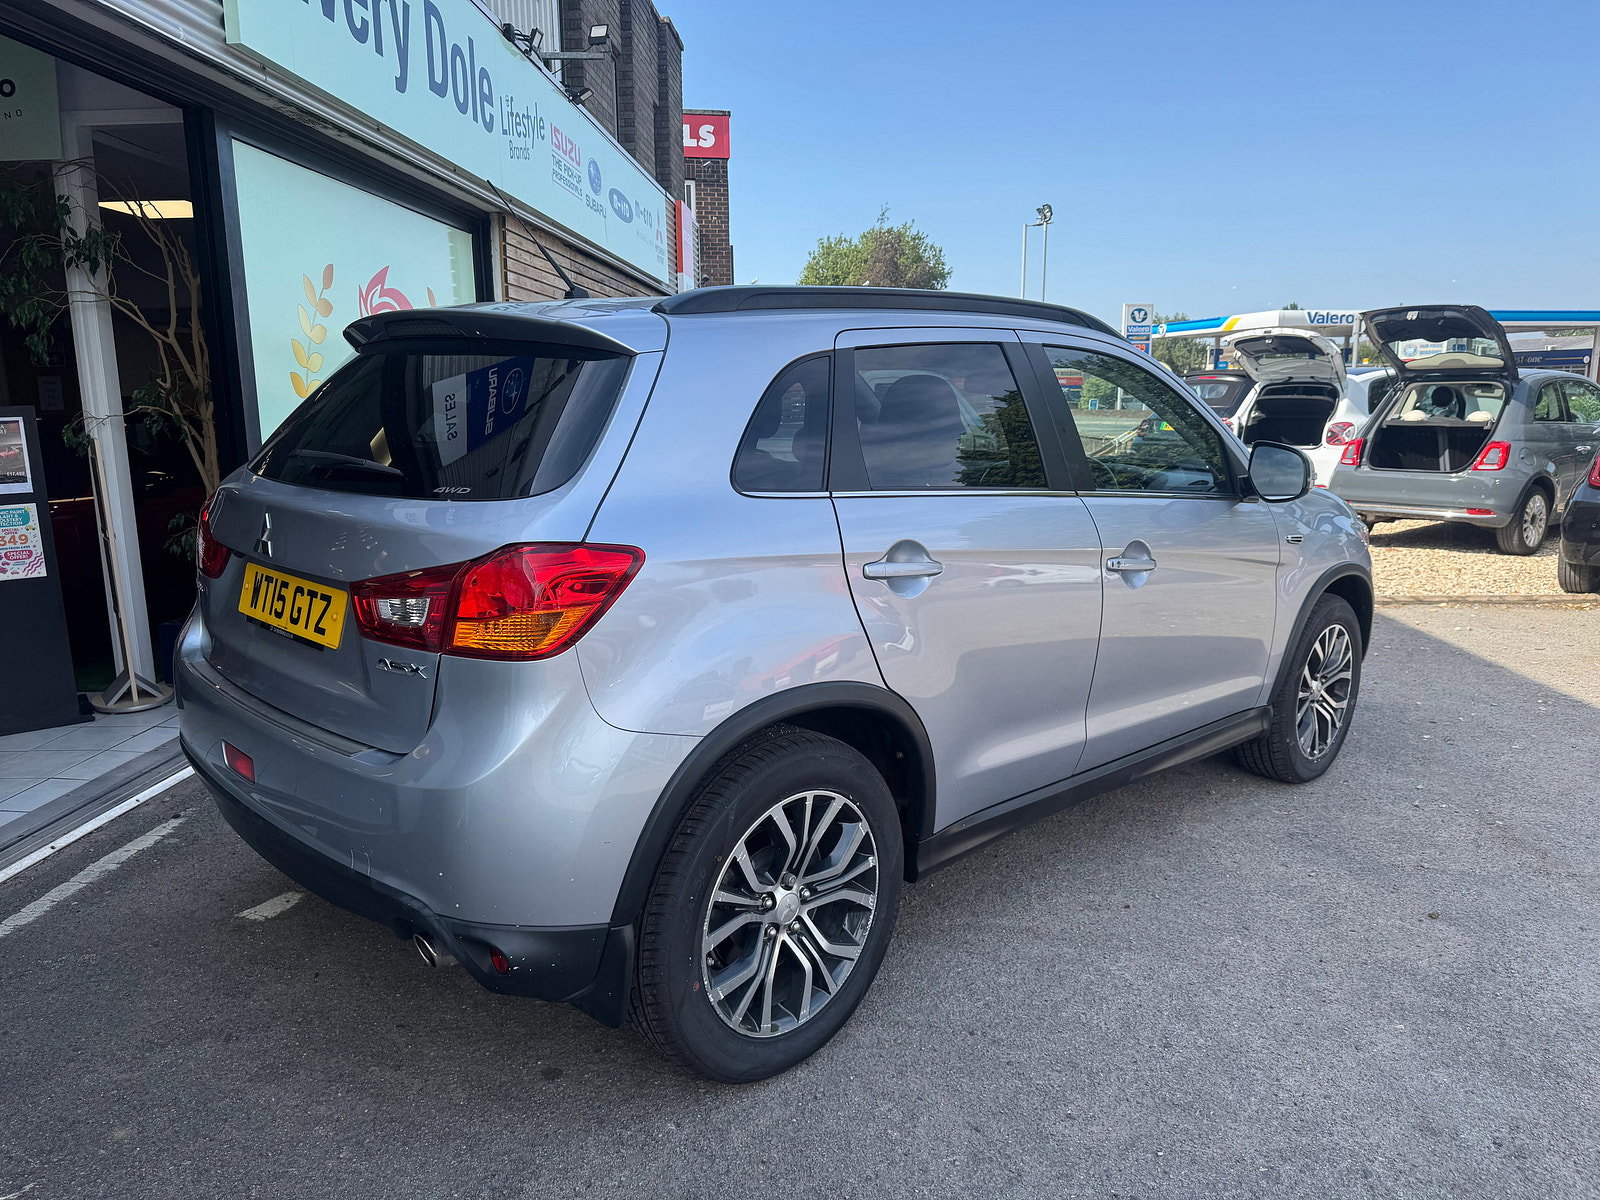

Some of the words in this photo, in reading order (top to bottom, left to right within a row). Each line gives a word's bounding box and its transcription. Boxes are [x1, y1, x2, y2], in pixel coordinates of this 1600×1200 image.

[301, 0, 410, 93] ery
[424, 0, 494, 133] Dole
[500, 95, 545, 149] Lifestyle
[550, 123, 580, 167] ISUZU
[683, 124, 715, 147] LS
[509, 140, 530, 160] Brands
[552, 154, 562, 171] THE
[585, 193, 607, 219] SUBARU
[1307, 311, 1355, 324] Valero
[433, 486, 471, 494] 4WD
[250, 571, 290, 619] WT15
[289, 586, 333, 637] GTZ
